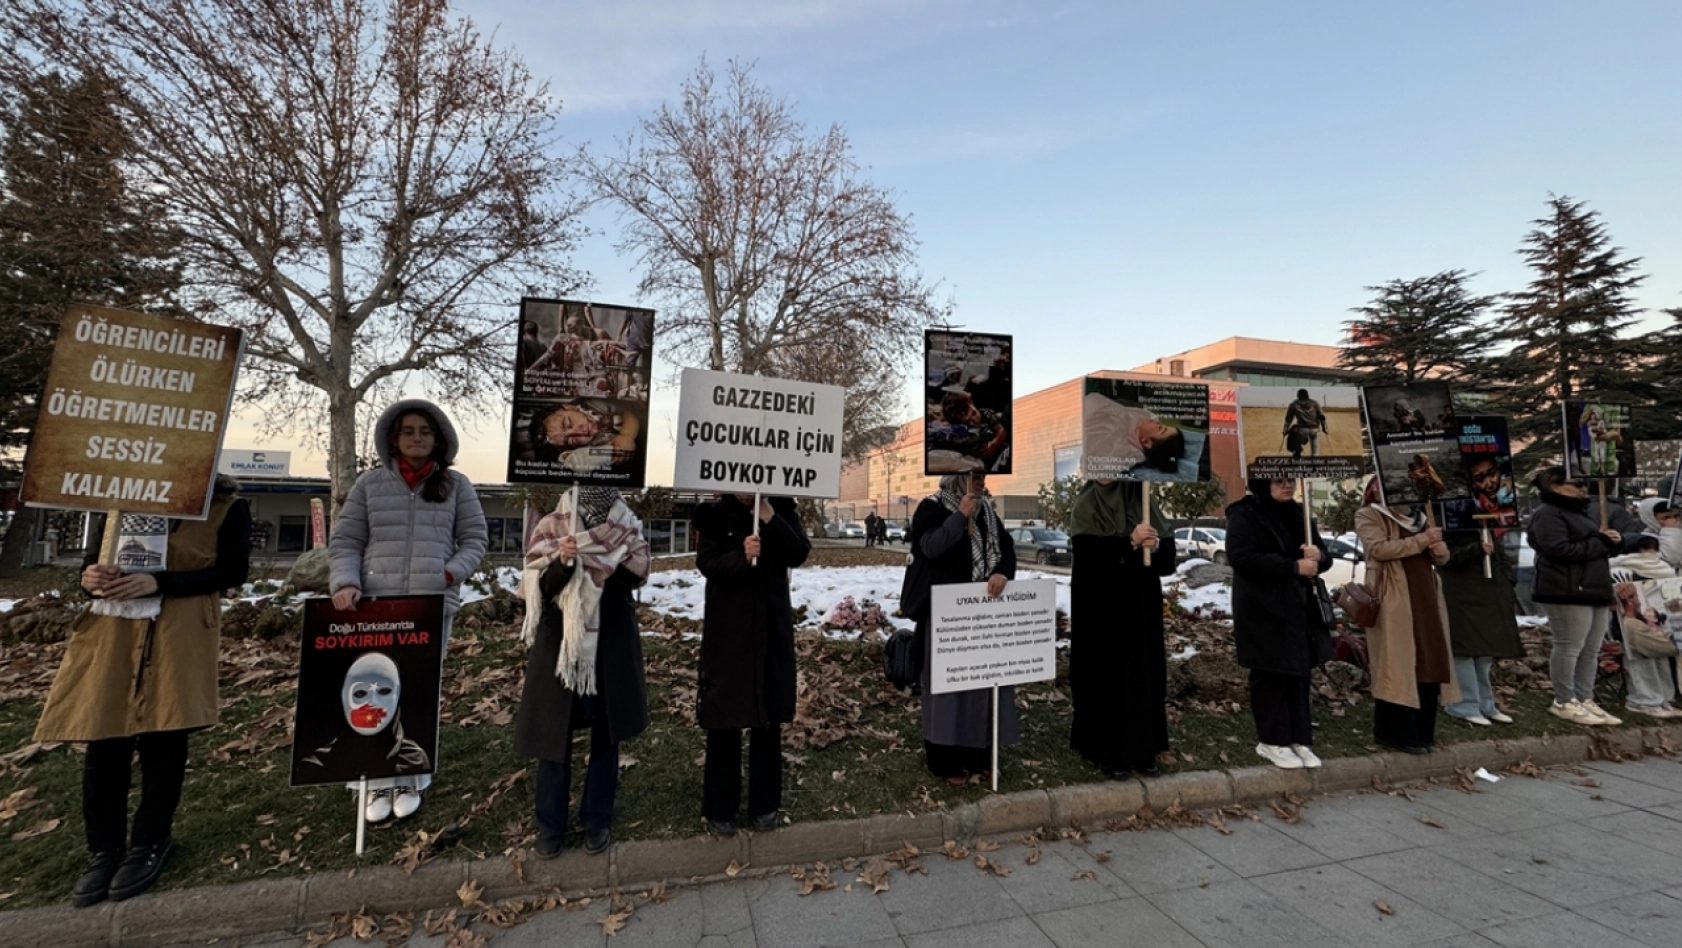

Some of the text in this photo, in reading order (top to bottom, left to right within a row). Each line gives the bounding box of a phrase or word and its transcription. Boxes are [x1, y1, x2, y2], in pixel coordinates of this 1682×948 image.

[75, 314, 226, 360] ÖĞRENCİLERİ
[90, 354, 195, 392] ÖLÜRKEN
[48, 387, 217, 432] ÖĞRETMENLER
[713, 385, 814, 416] GAZZEDEKİ
[86, 436, 166, 464] SESSİZ
[686, 420, 834, 457] ÇOCUKLAR İÇİN
[61, 472, 172, 503] KALAMAZ
[700, 460, 817, 488] BOYKOT YAP
[956, 596, 980, 606] UYAN
[1006, 590, 1037, 602] YİĞİDİM
[314, 632, 430, 650] SOYKIRIM VAR
[330, 621, 414, 634] Doğu Türkistan'da
